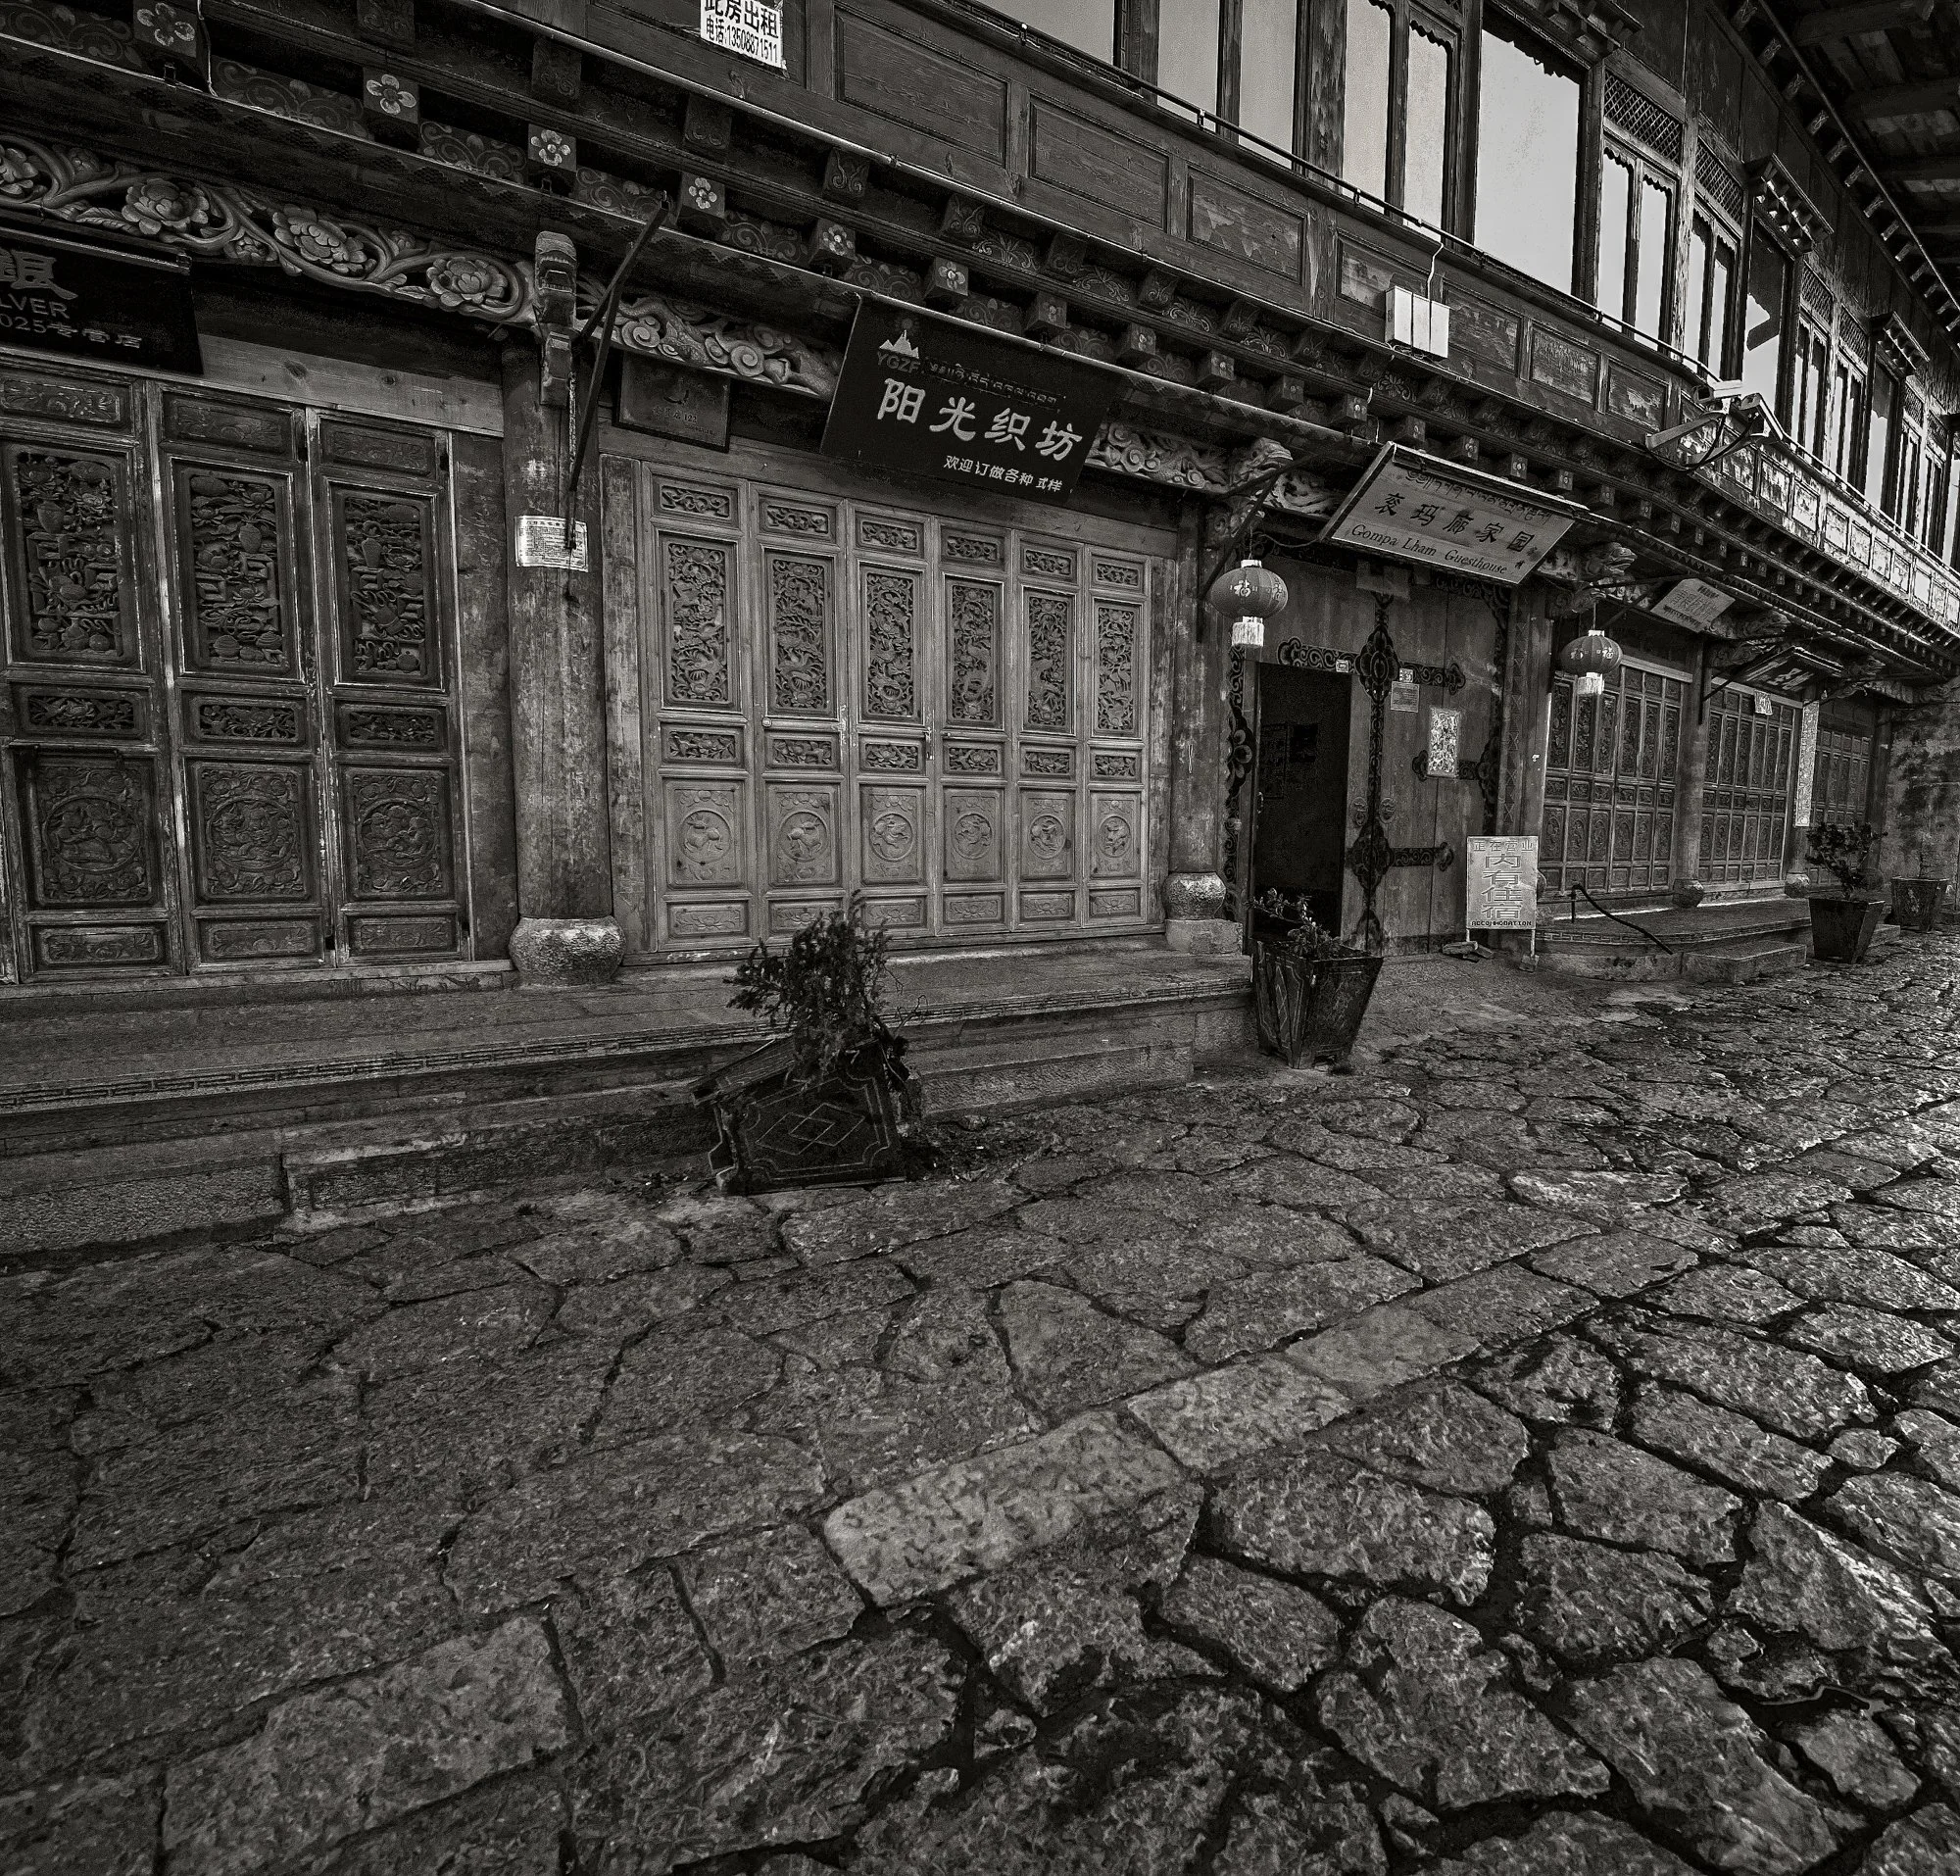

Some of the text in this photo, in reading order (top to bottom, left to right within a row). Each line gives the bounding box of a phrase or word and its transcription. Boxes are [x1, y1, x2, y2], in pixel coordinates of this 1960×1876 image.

[705, 0, 778, 38] 此房出租
[877, 351, 920, 374] YGZF
[877, 377, 1083, 461] 阳光织坊
[1351, 524, 1399, 548] Gompa
[1401, 537, 1437, 556] Lham
[1445, 549, 1508, 574] Guesthouse
[1473, 840, 1534, 852] 正在营业
[1481, 854, 1523, 919] 内有住宿
